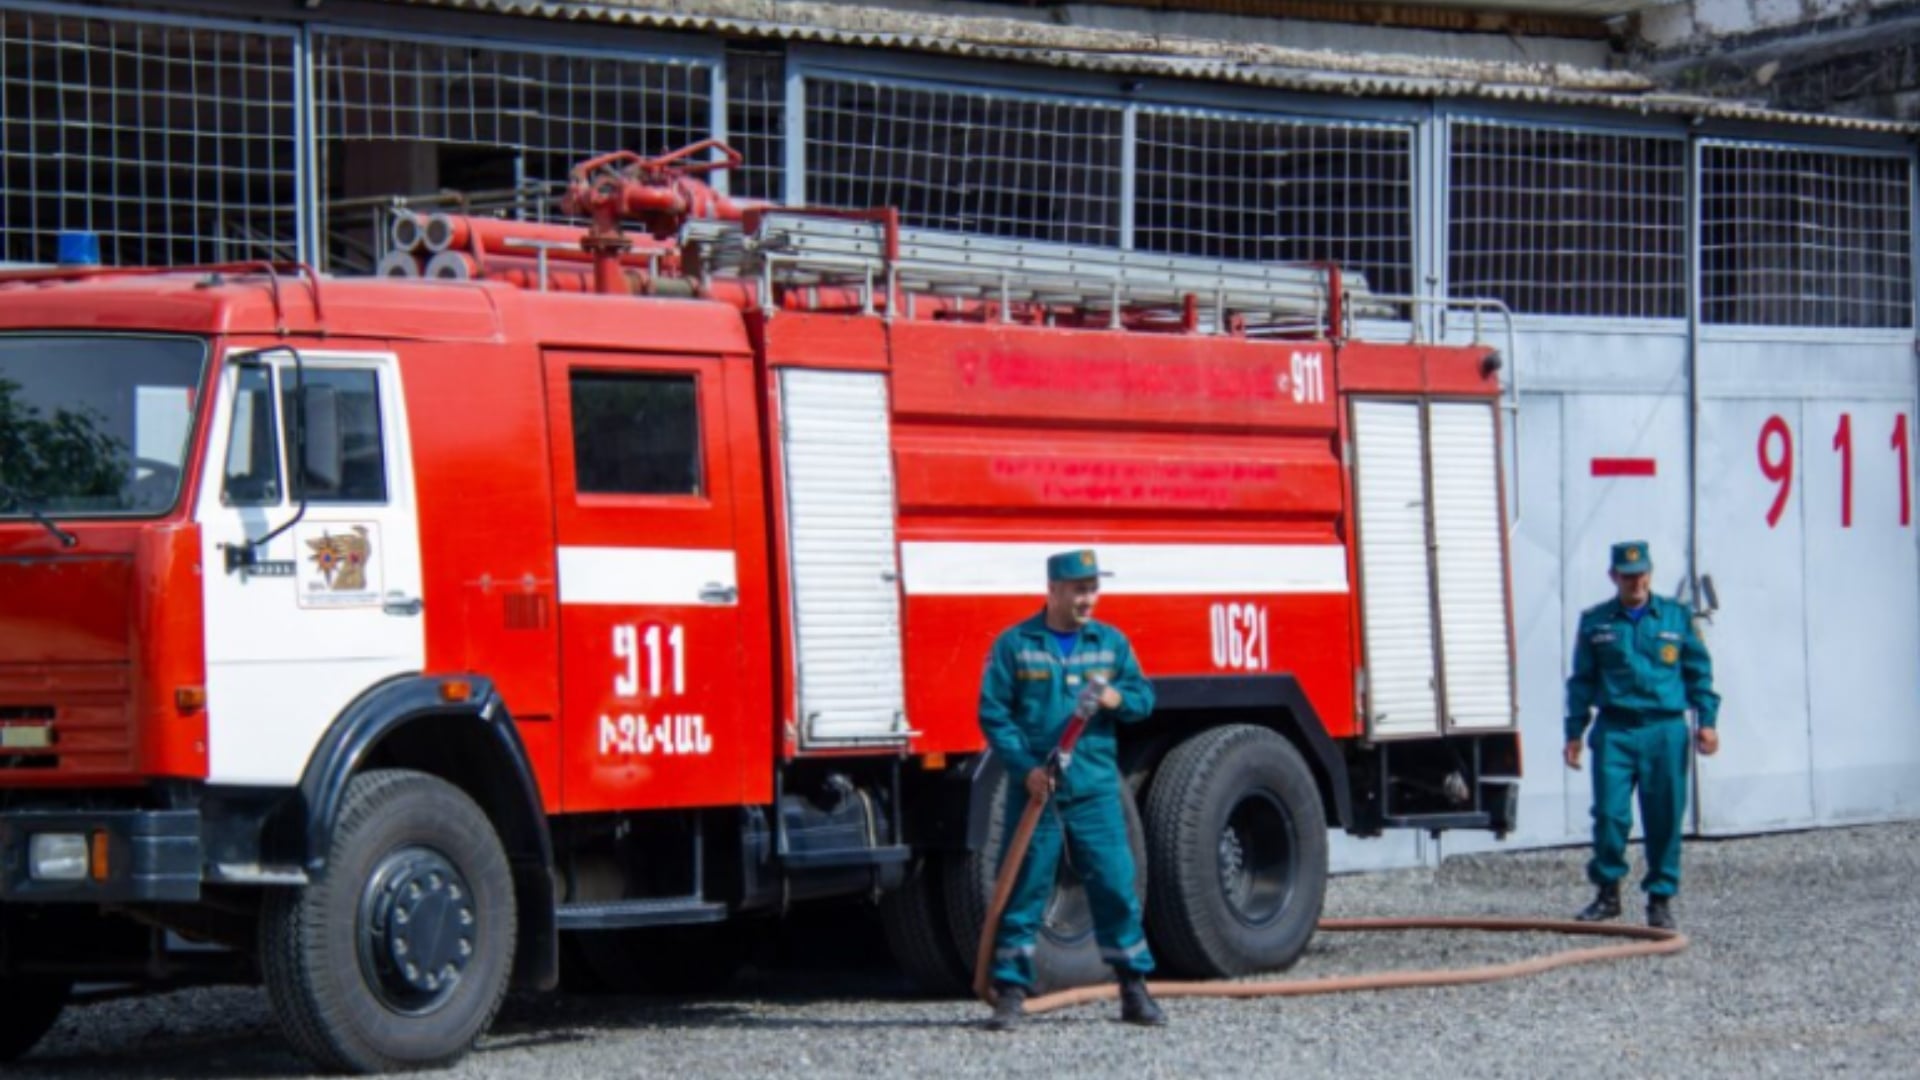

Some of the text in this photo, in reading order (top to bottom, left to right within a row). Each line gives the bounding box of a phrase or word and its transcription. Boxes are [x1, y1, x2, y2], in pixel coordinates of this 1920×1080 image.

[1290, 350, 1326, 405] 911
[612, 624, 685, 699] 911
[1209, 602, 1268, 672] 0621
[599, 713, 713, 756] ԻՋԵՎԱՆ
